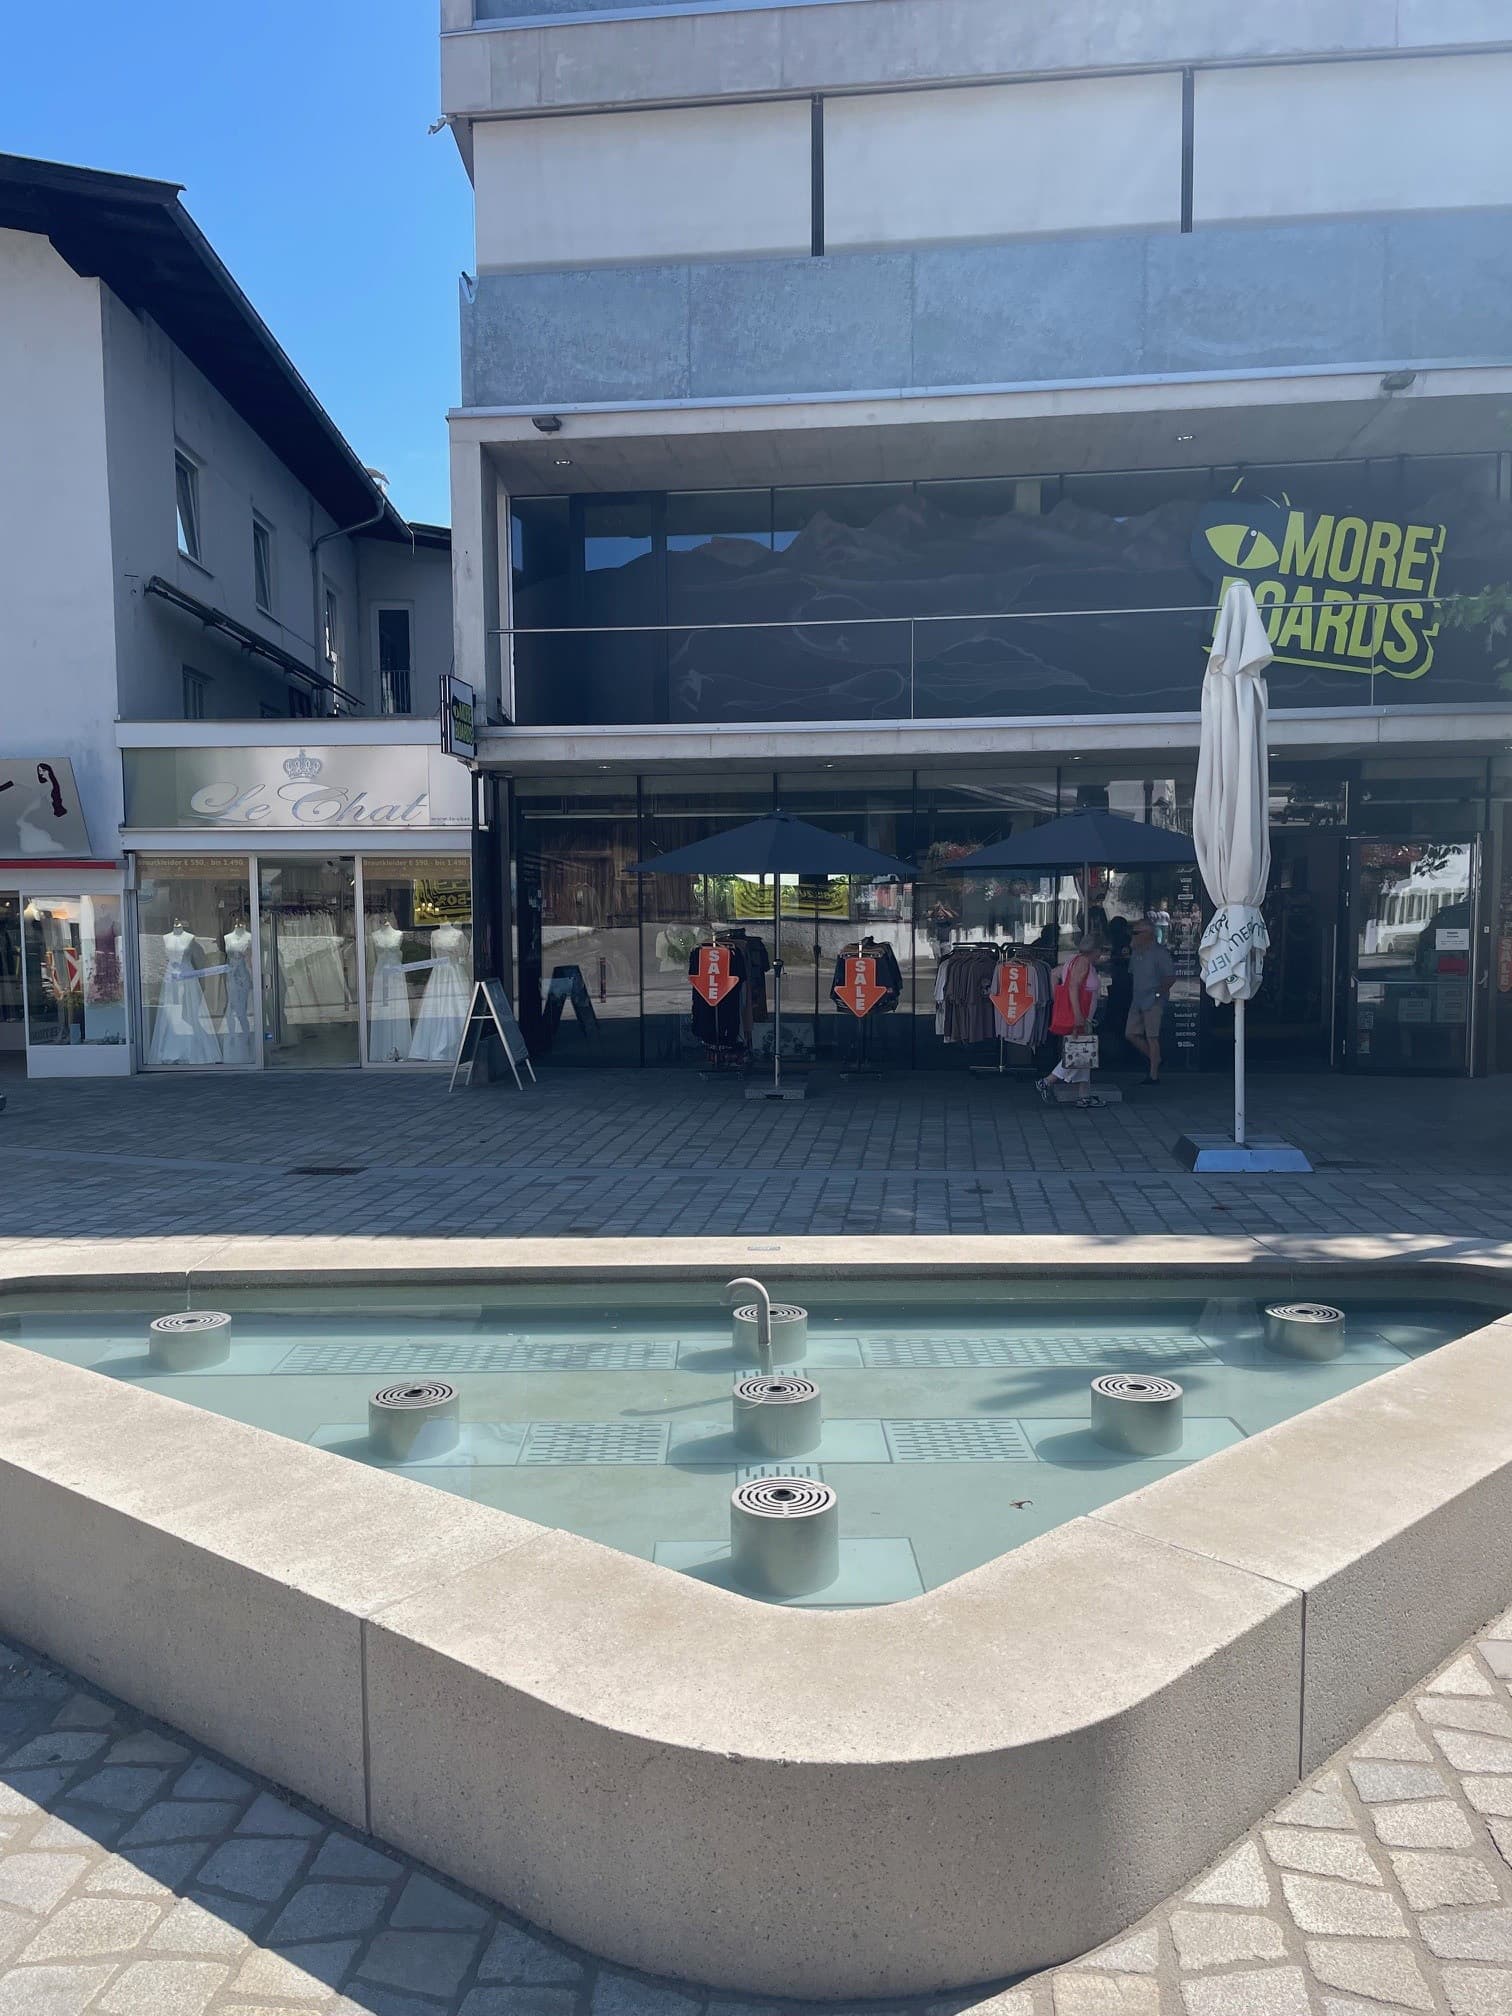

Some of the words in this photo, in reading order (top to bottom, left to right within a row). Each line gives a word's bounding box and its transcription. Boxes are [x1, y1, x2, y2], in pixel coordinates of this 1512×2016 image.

[1278, 510, 1435, 591] MORE
[1211, 575, 1424, 664] OARDS
[189, 781, 272, 822] Le
[277, 781, 429, 823] Chat
[707, 950, 720, 1000] SALE
[854, 960, 867, 1011] SALE
[1007, 967, 1019, 1018] SALE
